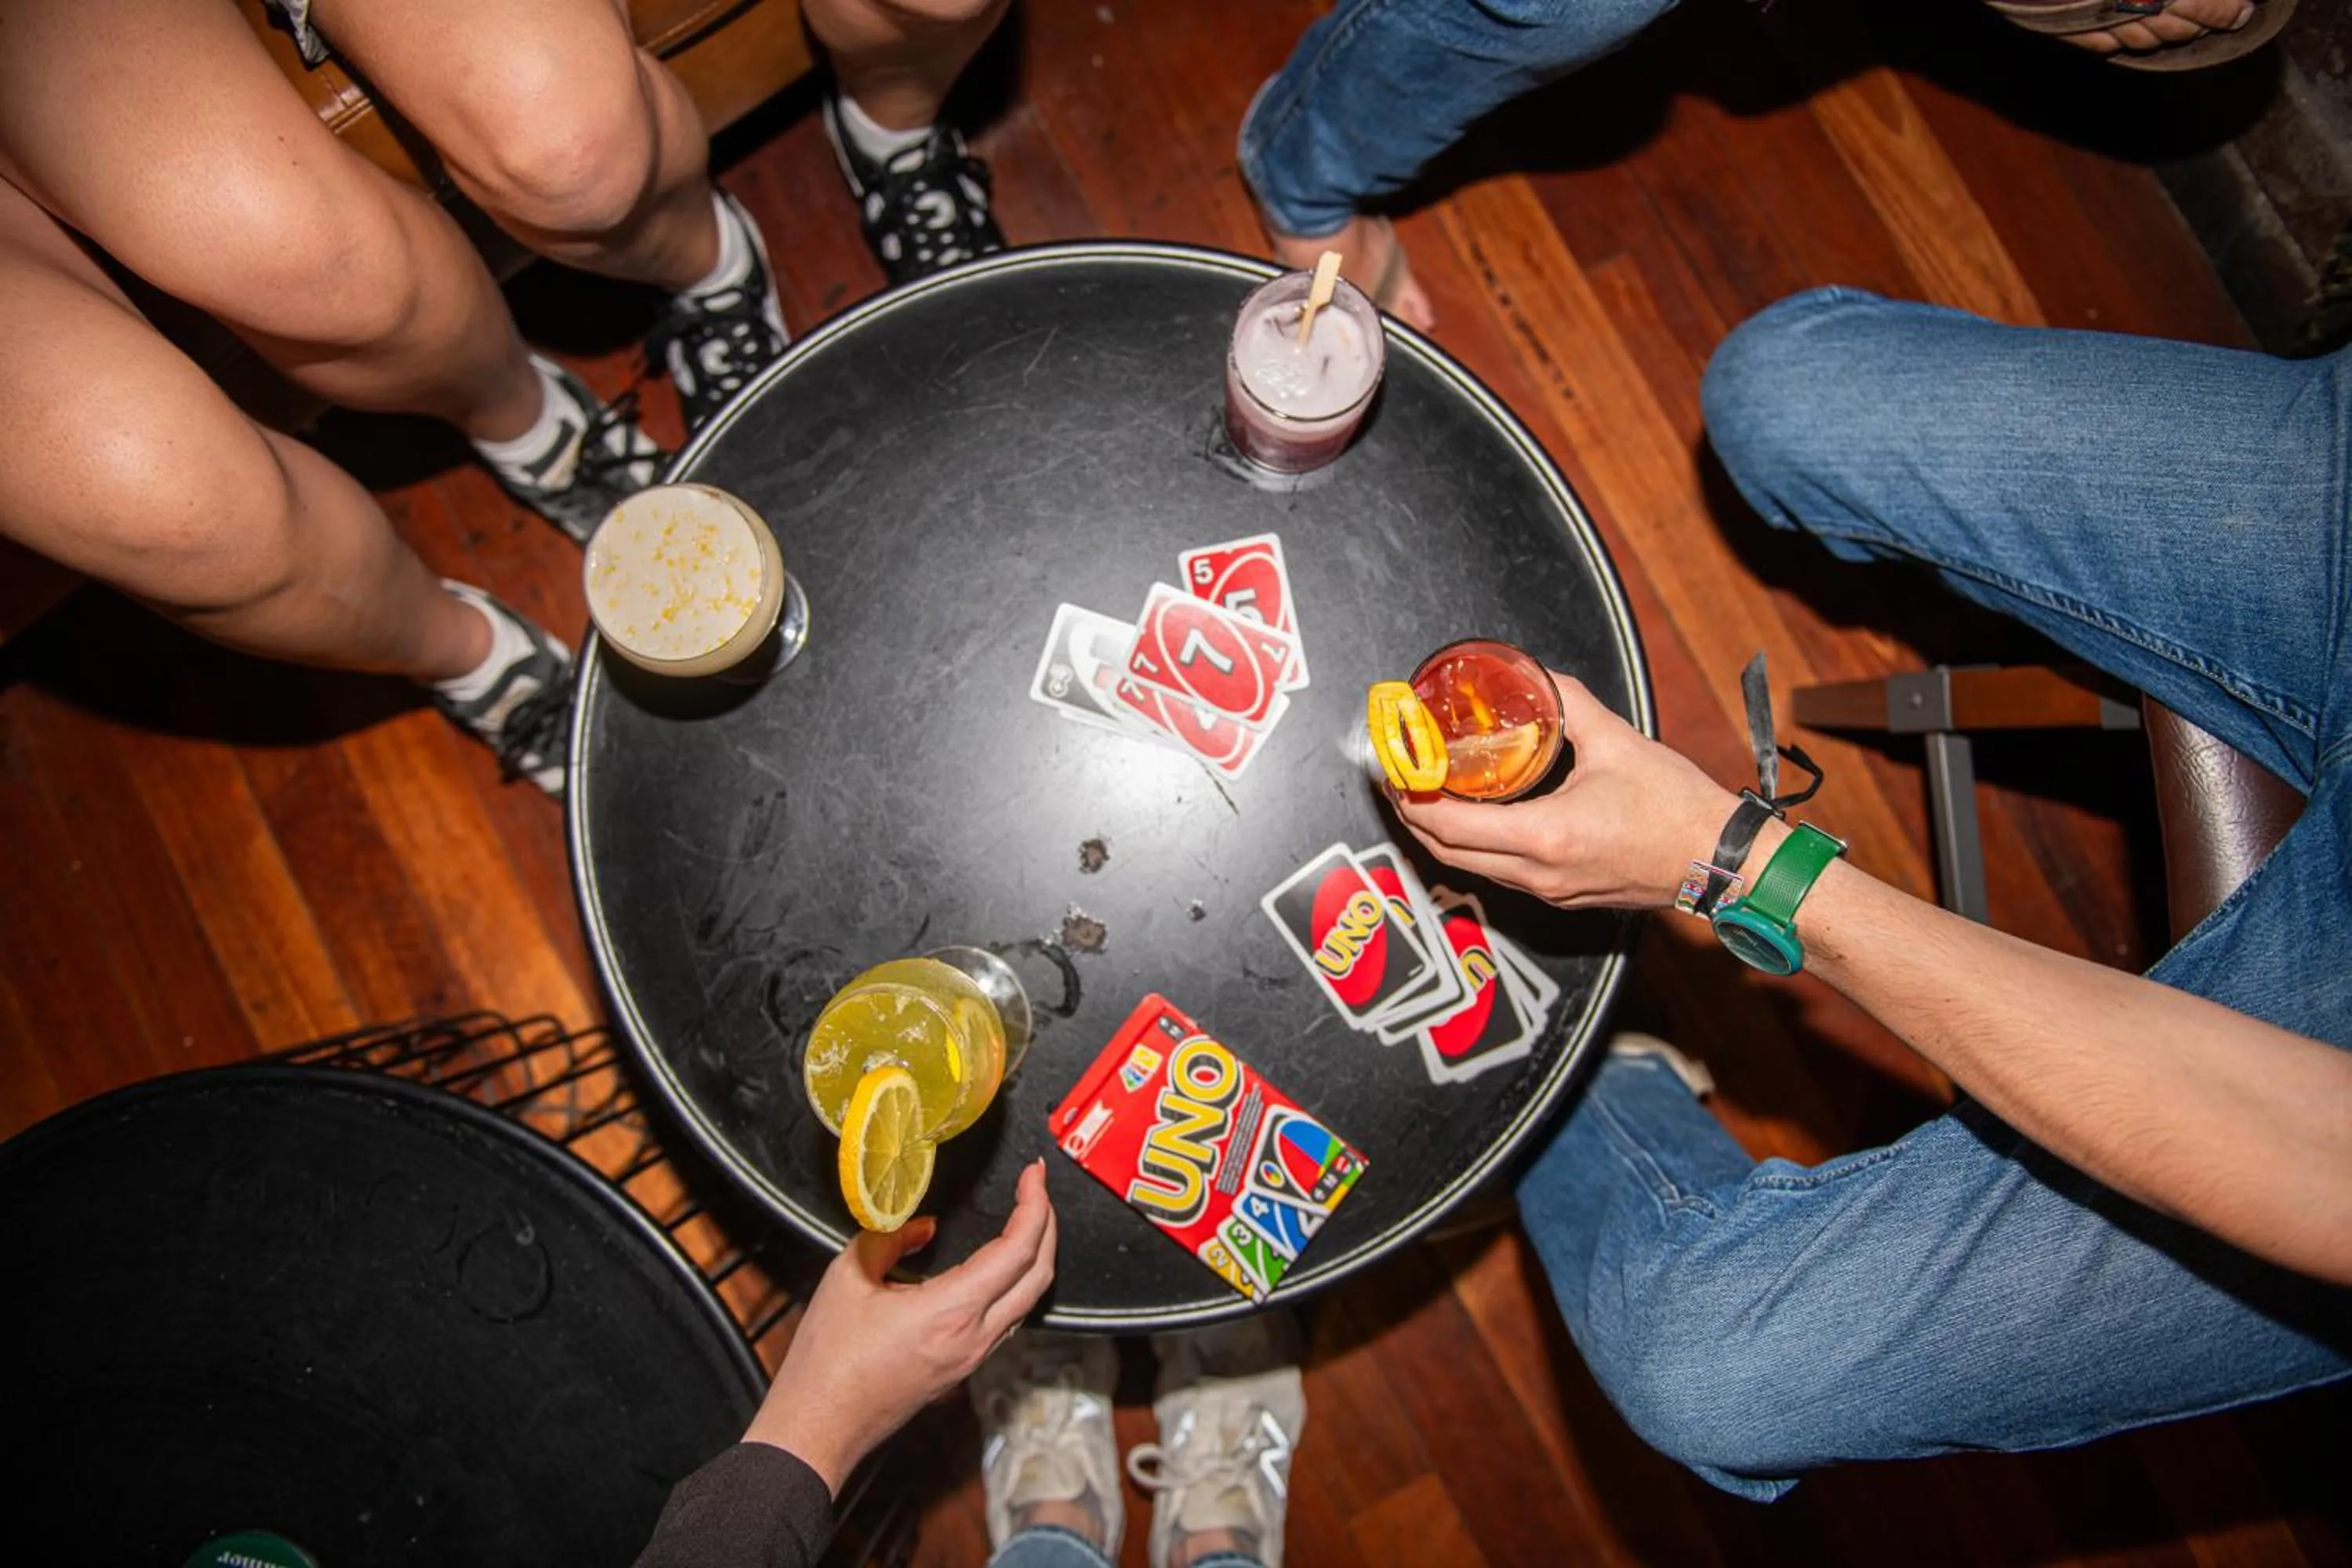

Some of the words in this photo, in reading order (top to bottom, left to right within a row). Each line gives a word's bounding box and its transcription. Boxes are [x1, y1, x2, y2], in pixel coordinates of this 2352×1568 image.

[1192, 558, 1214, 584] 5
[1178, 629, 1234, 672] 7
[1133, 653, 1159, 673] 7
[1121, 680, 1145, 701] 7
[1314, 891, 1385, 979] UNO
[1126, 1035, 1243, 1228] UNO
[1250, 1197, 1269, 1217] 4
[1232, 1224, 1252, 1245] 3
[1210, 1247, 1229, 1267] 2
